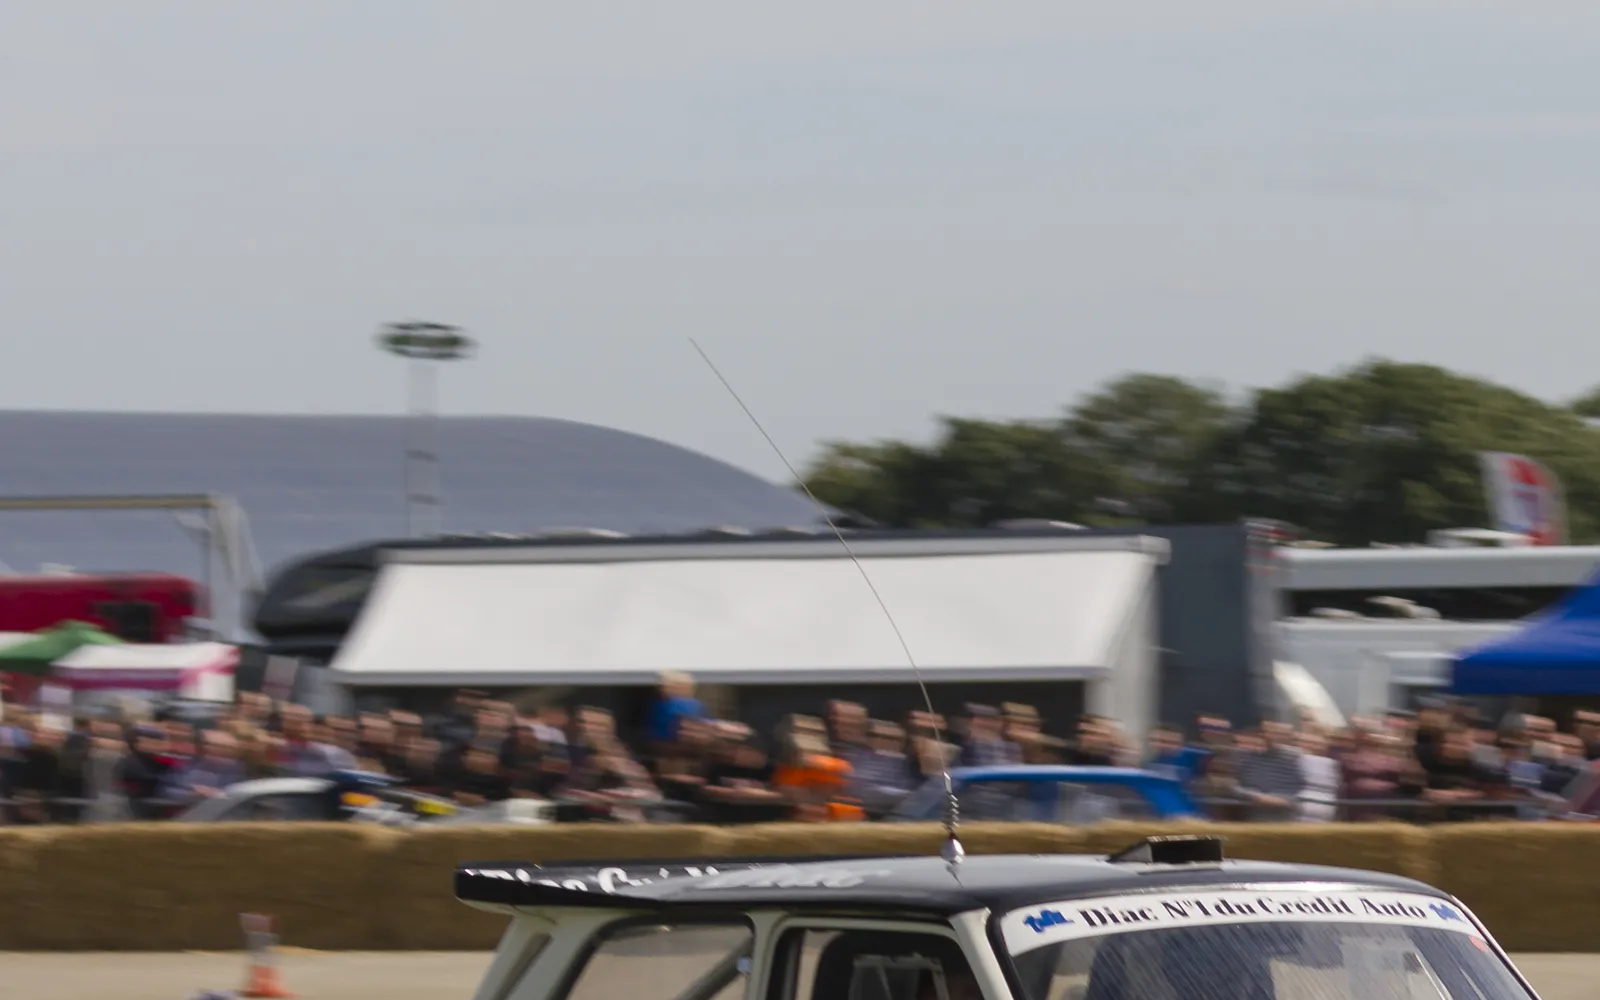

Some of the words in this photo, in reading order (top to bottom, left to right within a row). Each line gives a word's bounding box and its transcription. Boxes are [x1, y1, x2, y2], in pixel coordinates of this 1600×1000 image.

[1078, 904, 1158, 928] Diac
[1213, 897, 1257, 915] du
[1359, 896, 1427, 918] Auto
